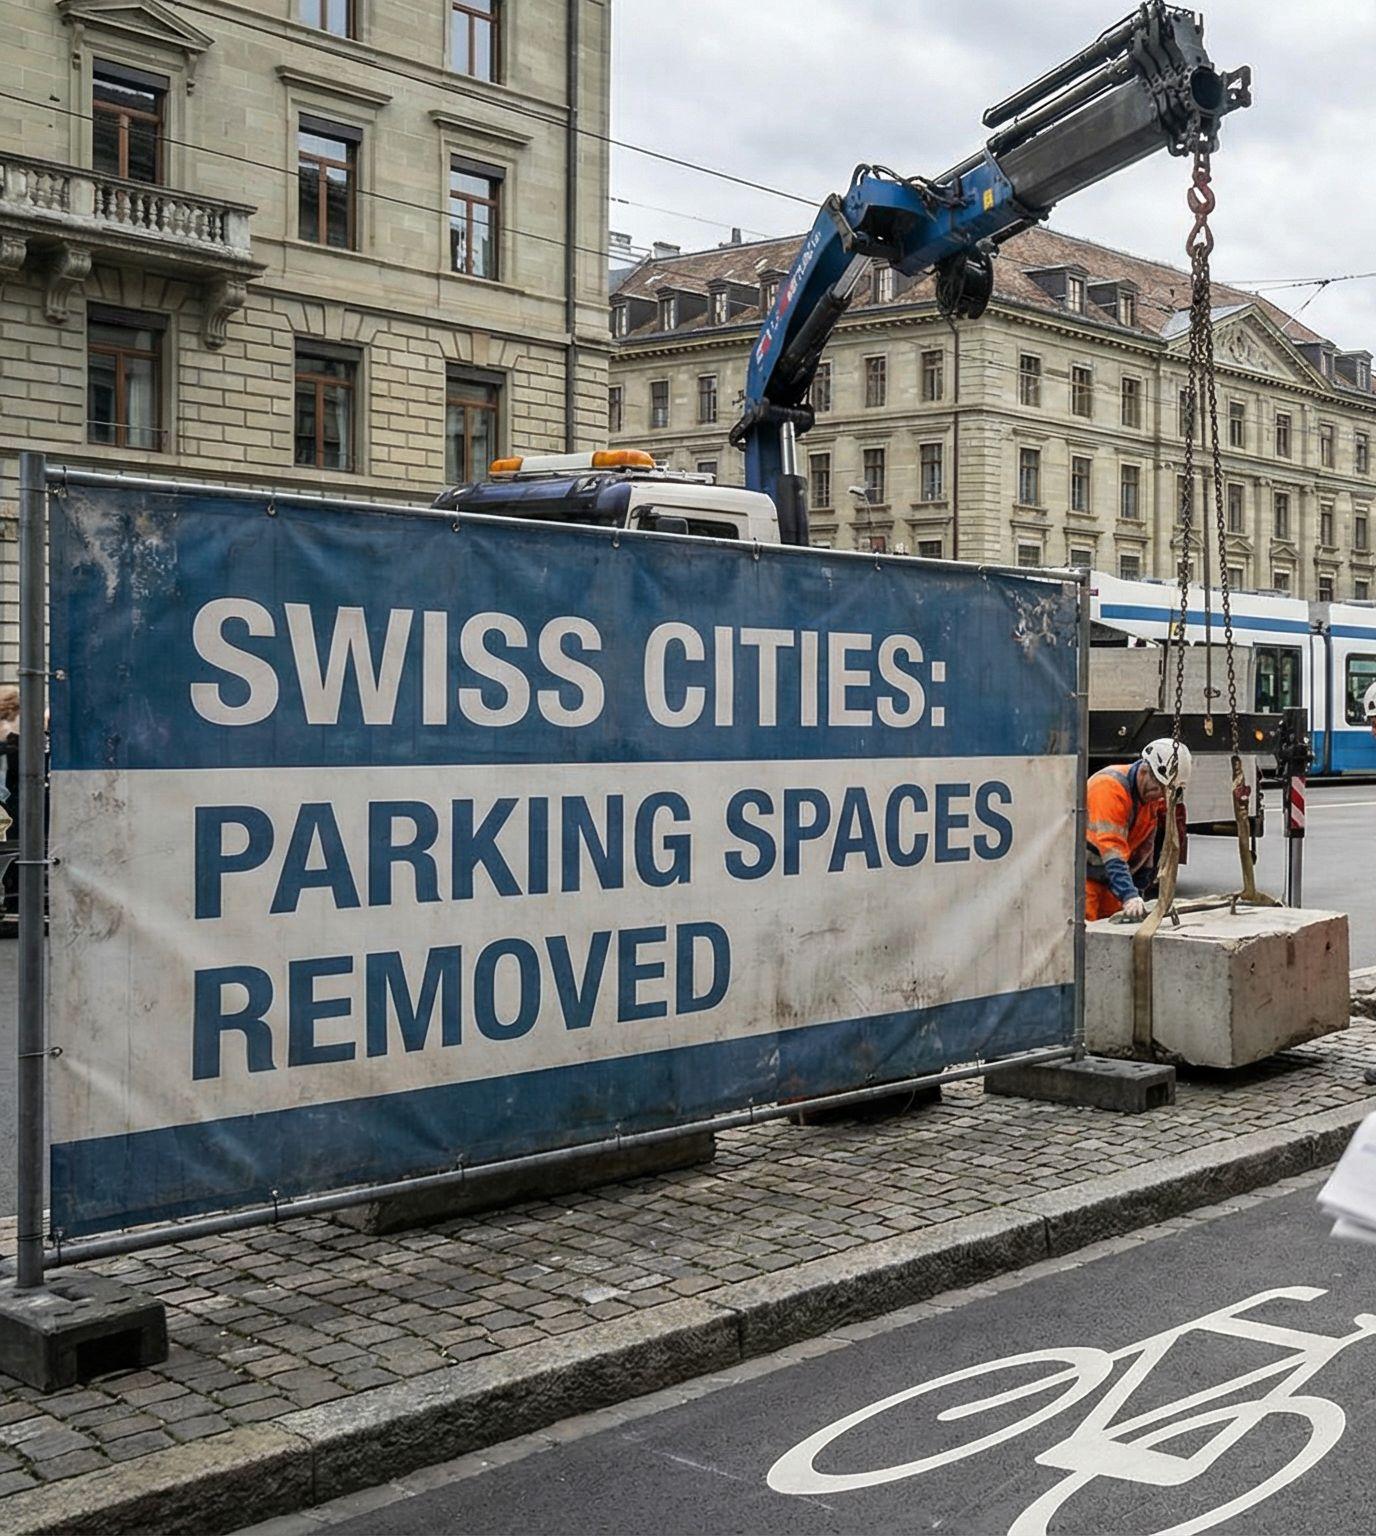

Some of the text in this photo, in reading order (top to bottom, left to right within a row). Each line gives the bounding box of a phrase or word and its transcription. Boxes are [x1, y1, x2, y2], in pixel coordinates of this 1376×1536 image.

[190, 597, 946, 728] SWISS CITIES:
[194, 780, 1014, 920] PARKING SPACES
[192, 921, 732, 1081] REMOVED
